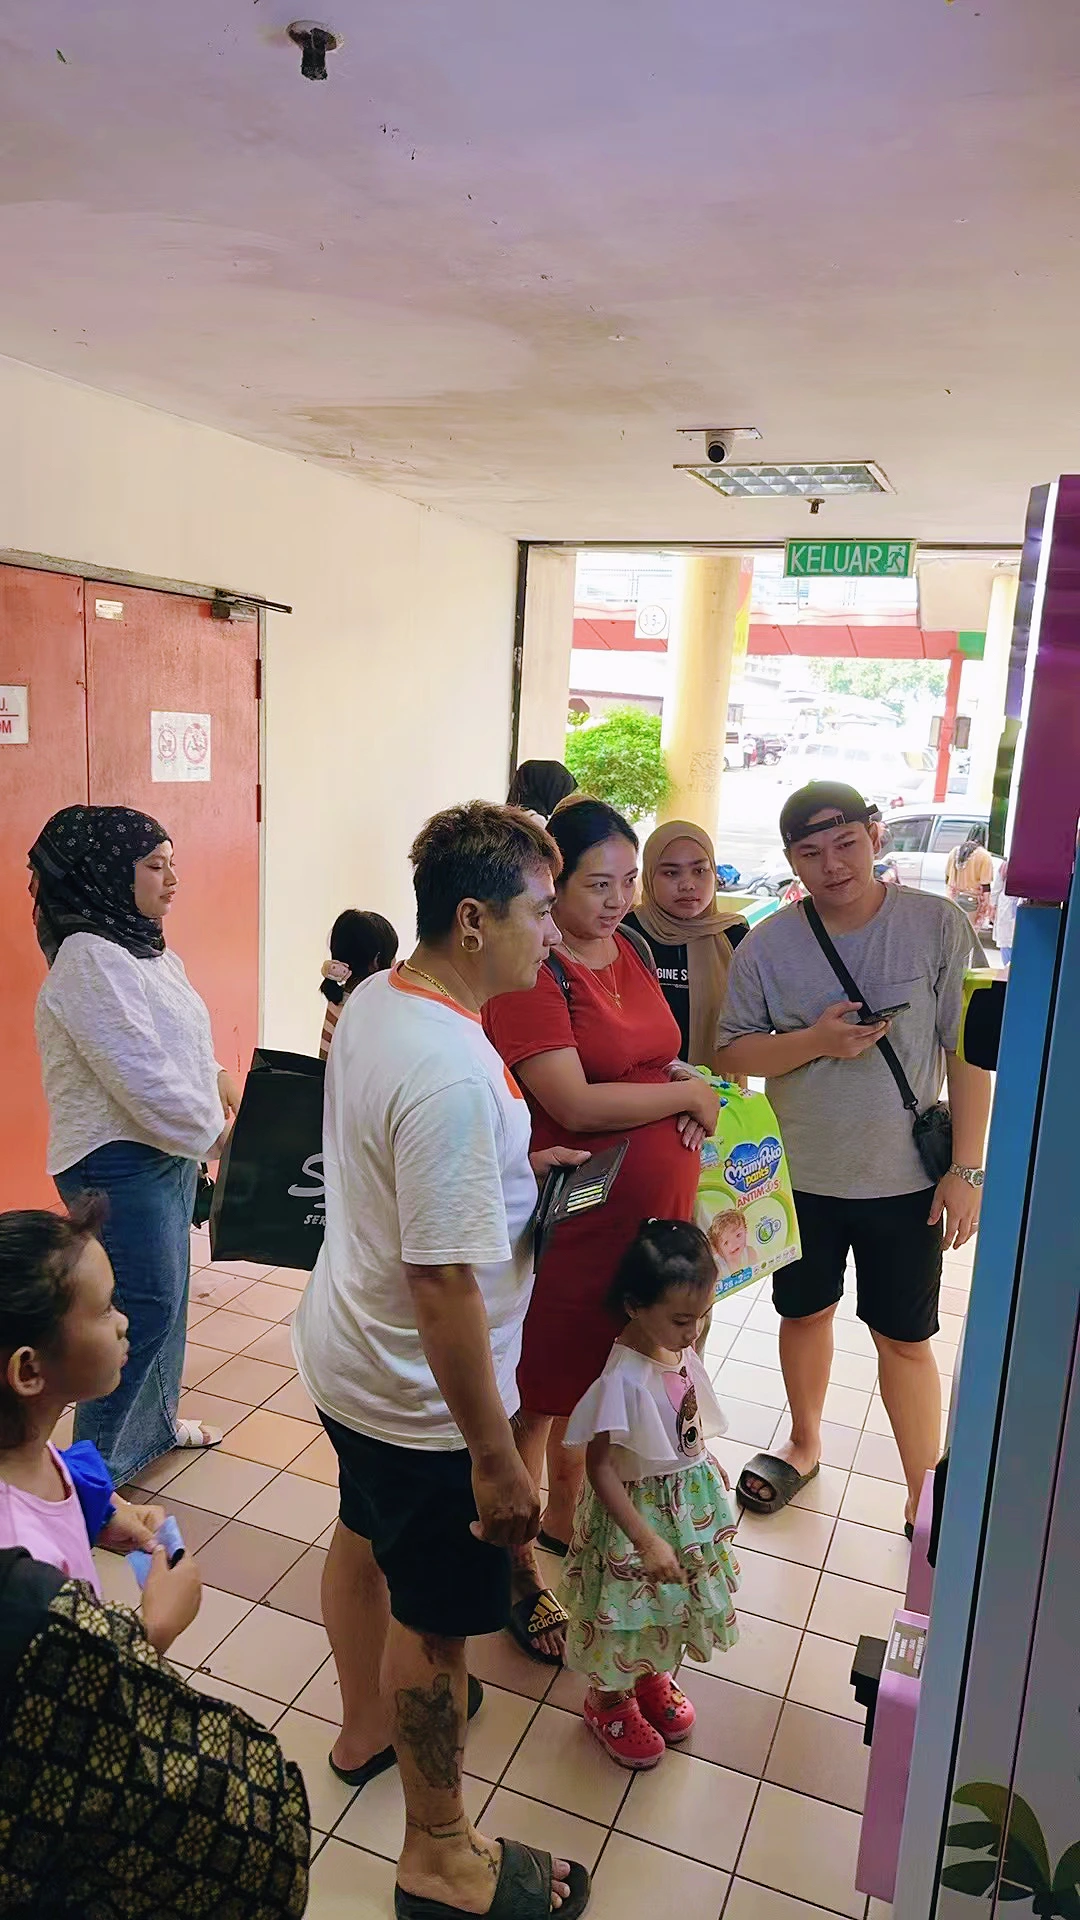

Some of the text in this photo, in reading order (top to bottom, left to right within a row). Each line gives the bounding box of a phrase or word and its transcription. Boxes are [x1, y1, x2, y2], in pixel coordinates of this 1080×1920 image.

[790, 545, 882, 573] KELUAR
[656, 967, 679, 980] GINE
[528, 1611, 569, 1633] adidas
